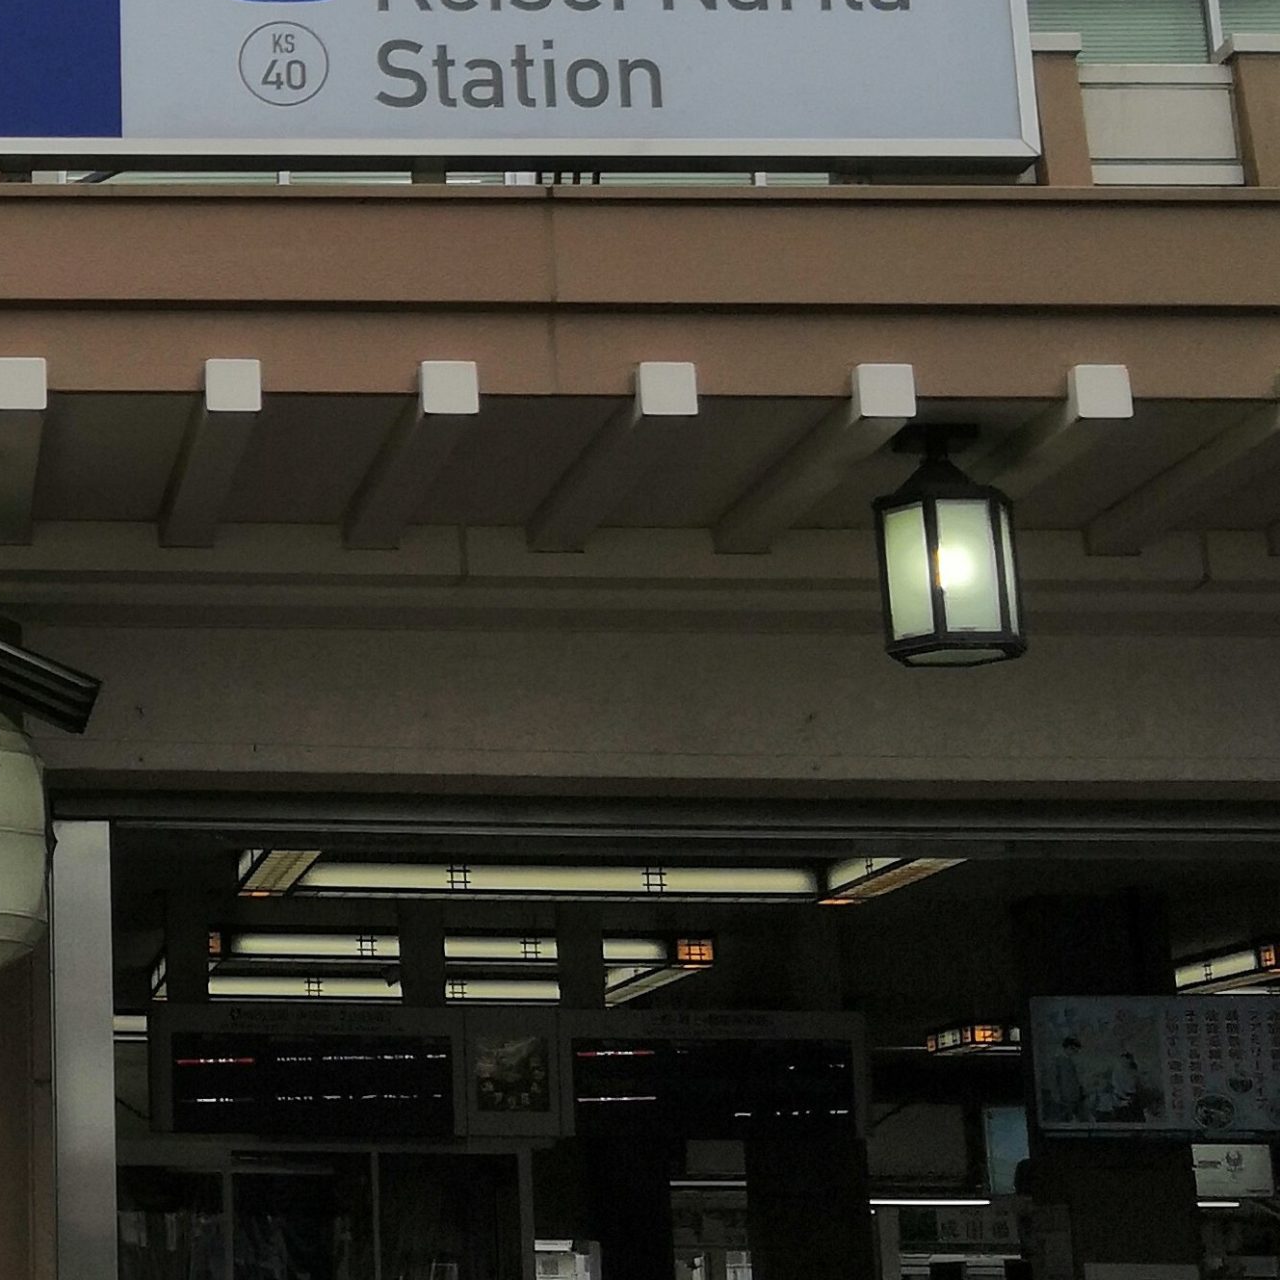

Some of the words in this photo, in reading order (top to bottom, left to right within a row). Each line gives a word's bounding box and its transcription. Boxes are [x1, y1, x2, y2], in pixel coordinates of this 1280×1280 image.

[271, 33, 296, 54] KS
[261, 59, 307, 91] 40
[375, 38, 664, 109] Station
